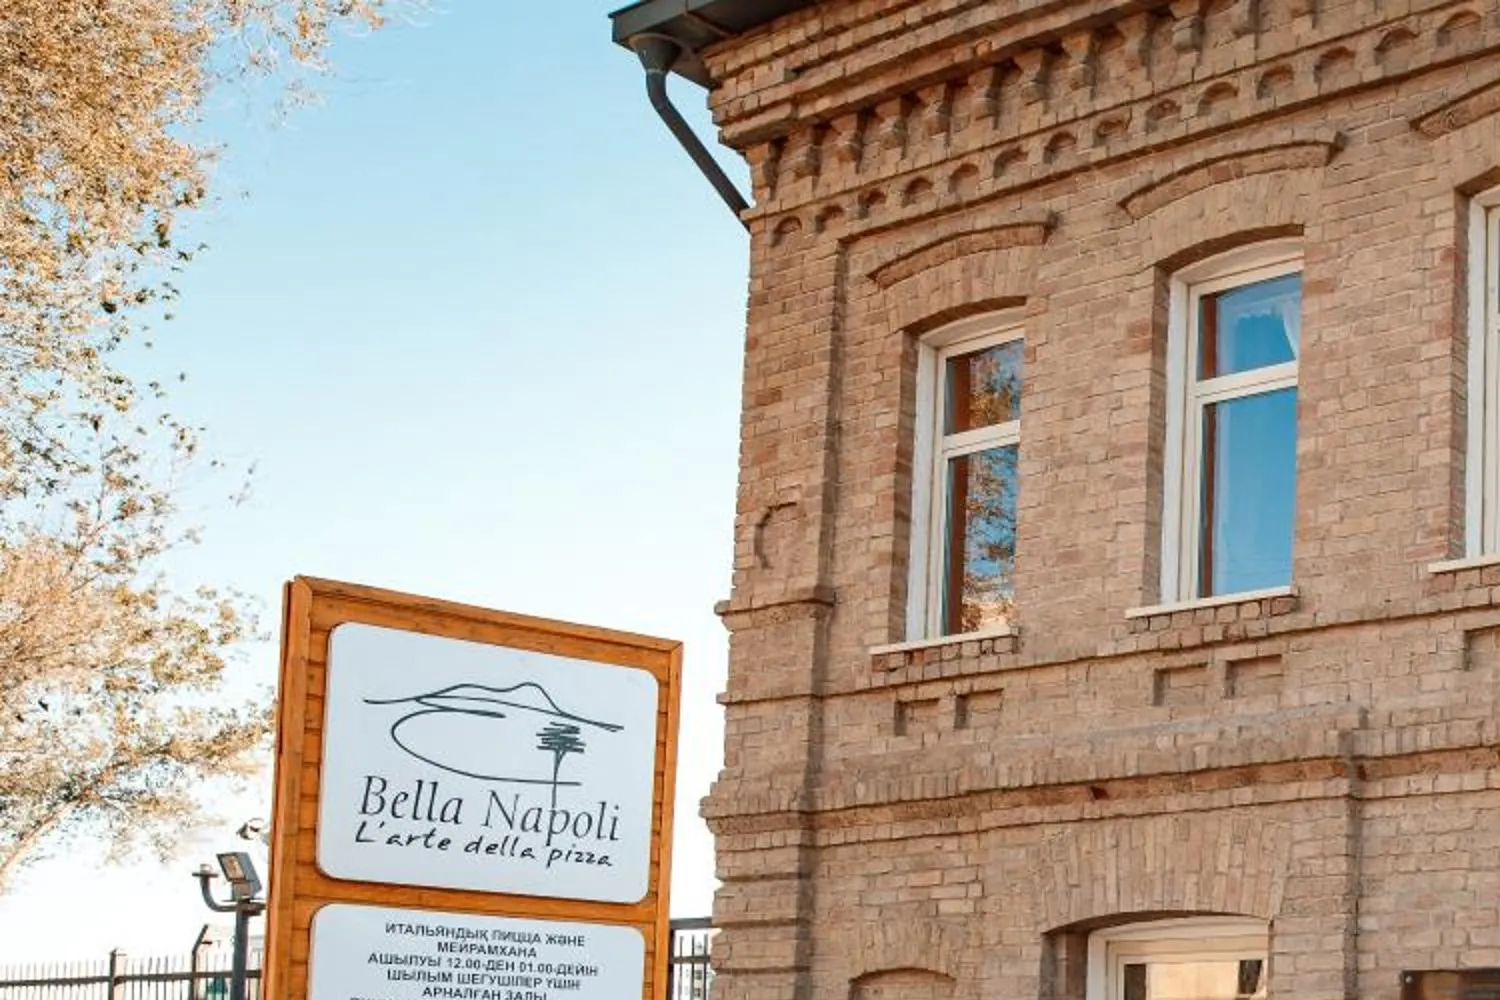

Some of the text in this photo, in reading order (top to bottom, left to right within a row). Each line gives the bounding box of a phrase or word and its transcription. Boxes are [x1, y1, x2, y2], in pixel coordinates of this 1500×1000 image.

[358, 775, 622, 847] Bella Napoli
[463, 835, 536, 859] della
[545, 843, 614, 869] pizza
[492, 930, 542, 944] ПИЦЦА
